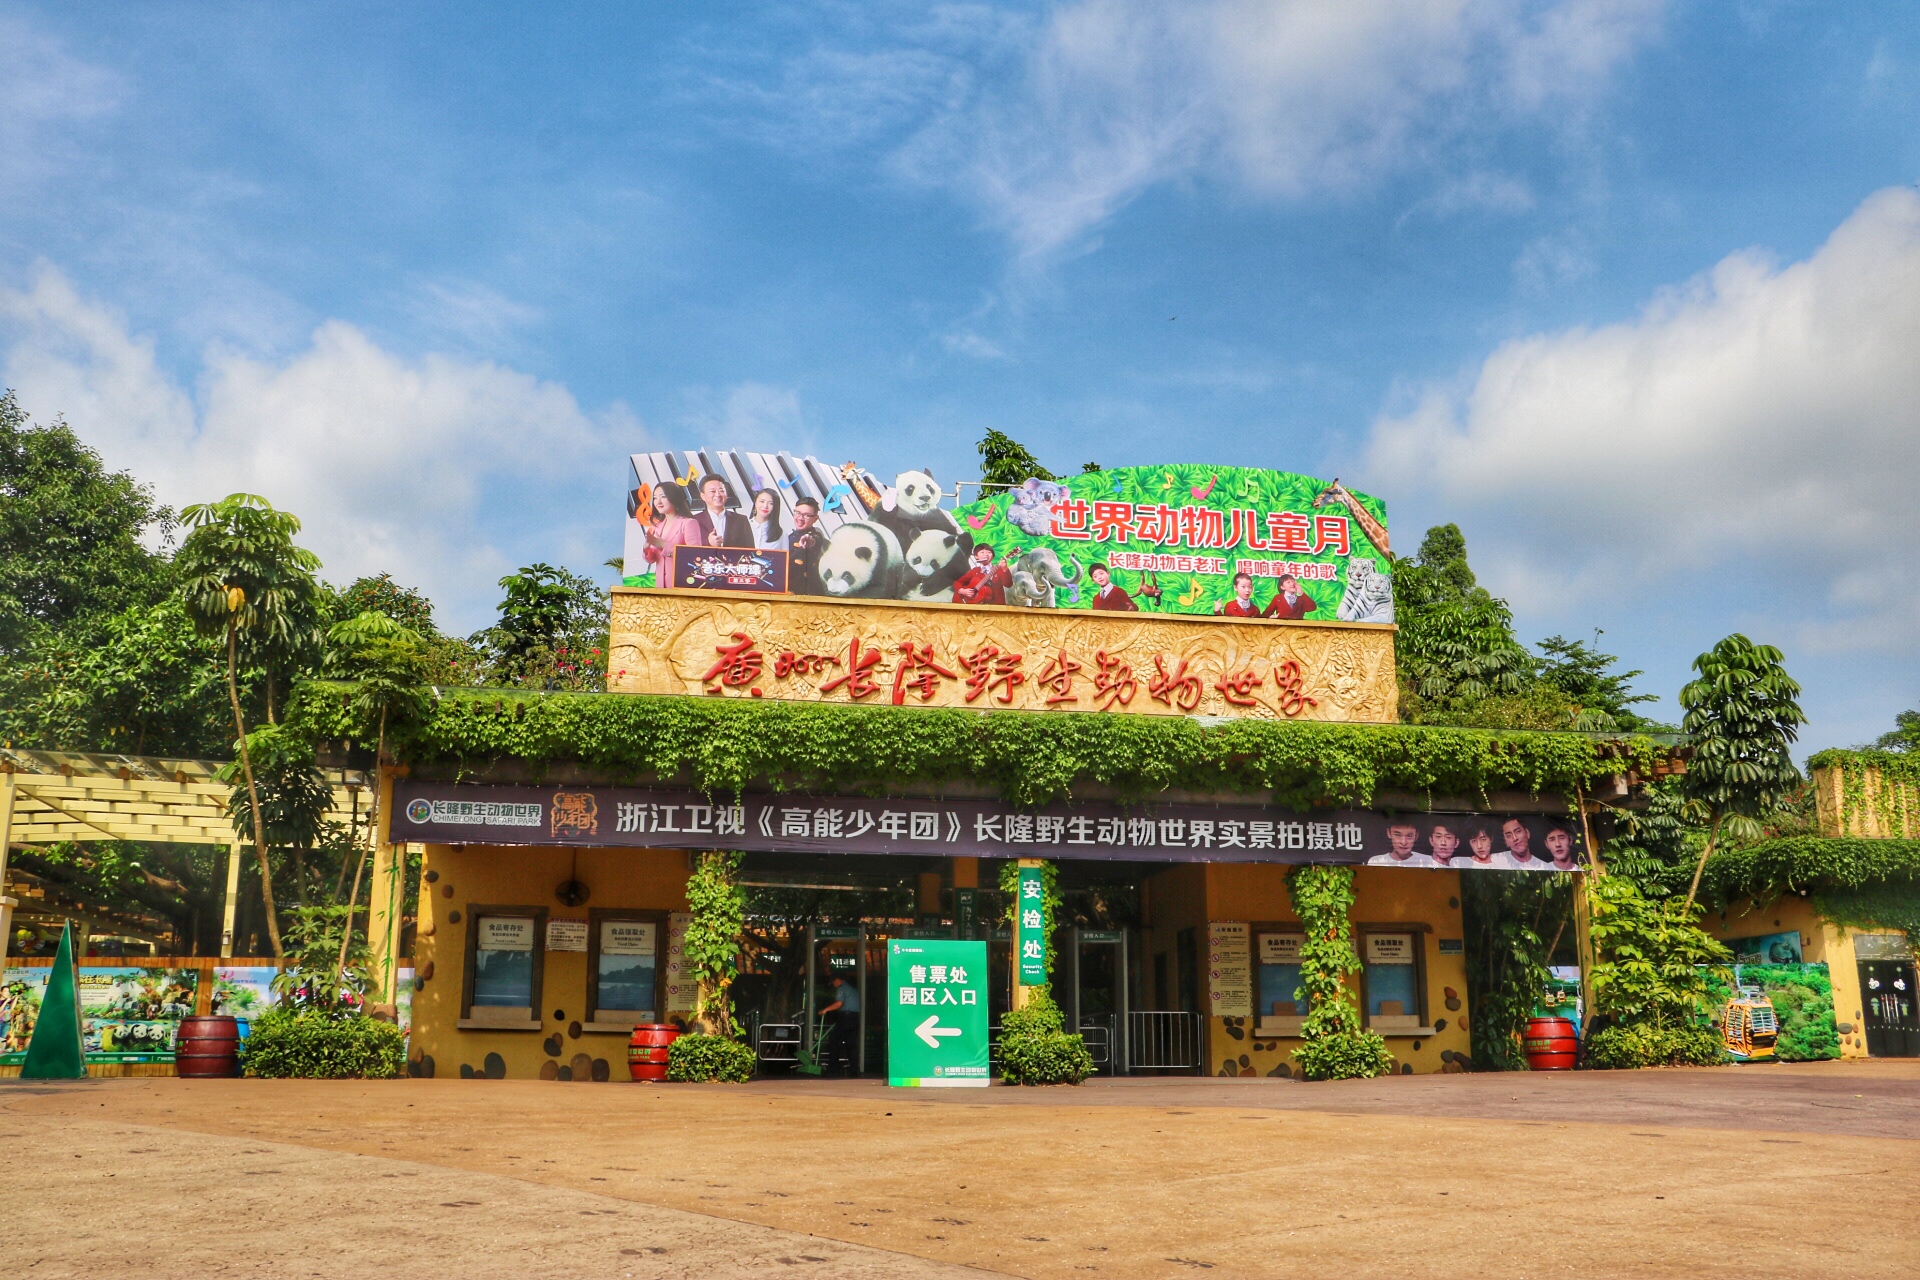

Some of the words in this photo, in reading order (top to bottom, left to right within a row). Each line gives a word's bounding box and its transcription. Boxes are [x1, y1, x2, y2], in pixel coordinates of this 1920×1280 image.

[1050, 498, 1350, 555] 世界动物儿童月
[701, 562, 761, 575] 音乐大师课
[1109, 551, 1227, 575] 长隆动物百老汇
[1237, 560, 1337, 580] 唱响童年的歌
[433, 802, 541, 817] 长隆野生动物世界
[432, 816, 482, 824] CHIMELONG
[486, 817, 516, 825] SAFARI
[489, 924, 524, 932] 食品寄存处
[1022, 879, 1043, 959] 安检处
[909, 965, 968, 984] 售票处
[900, 987, 976, 1005] 园区入口
